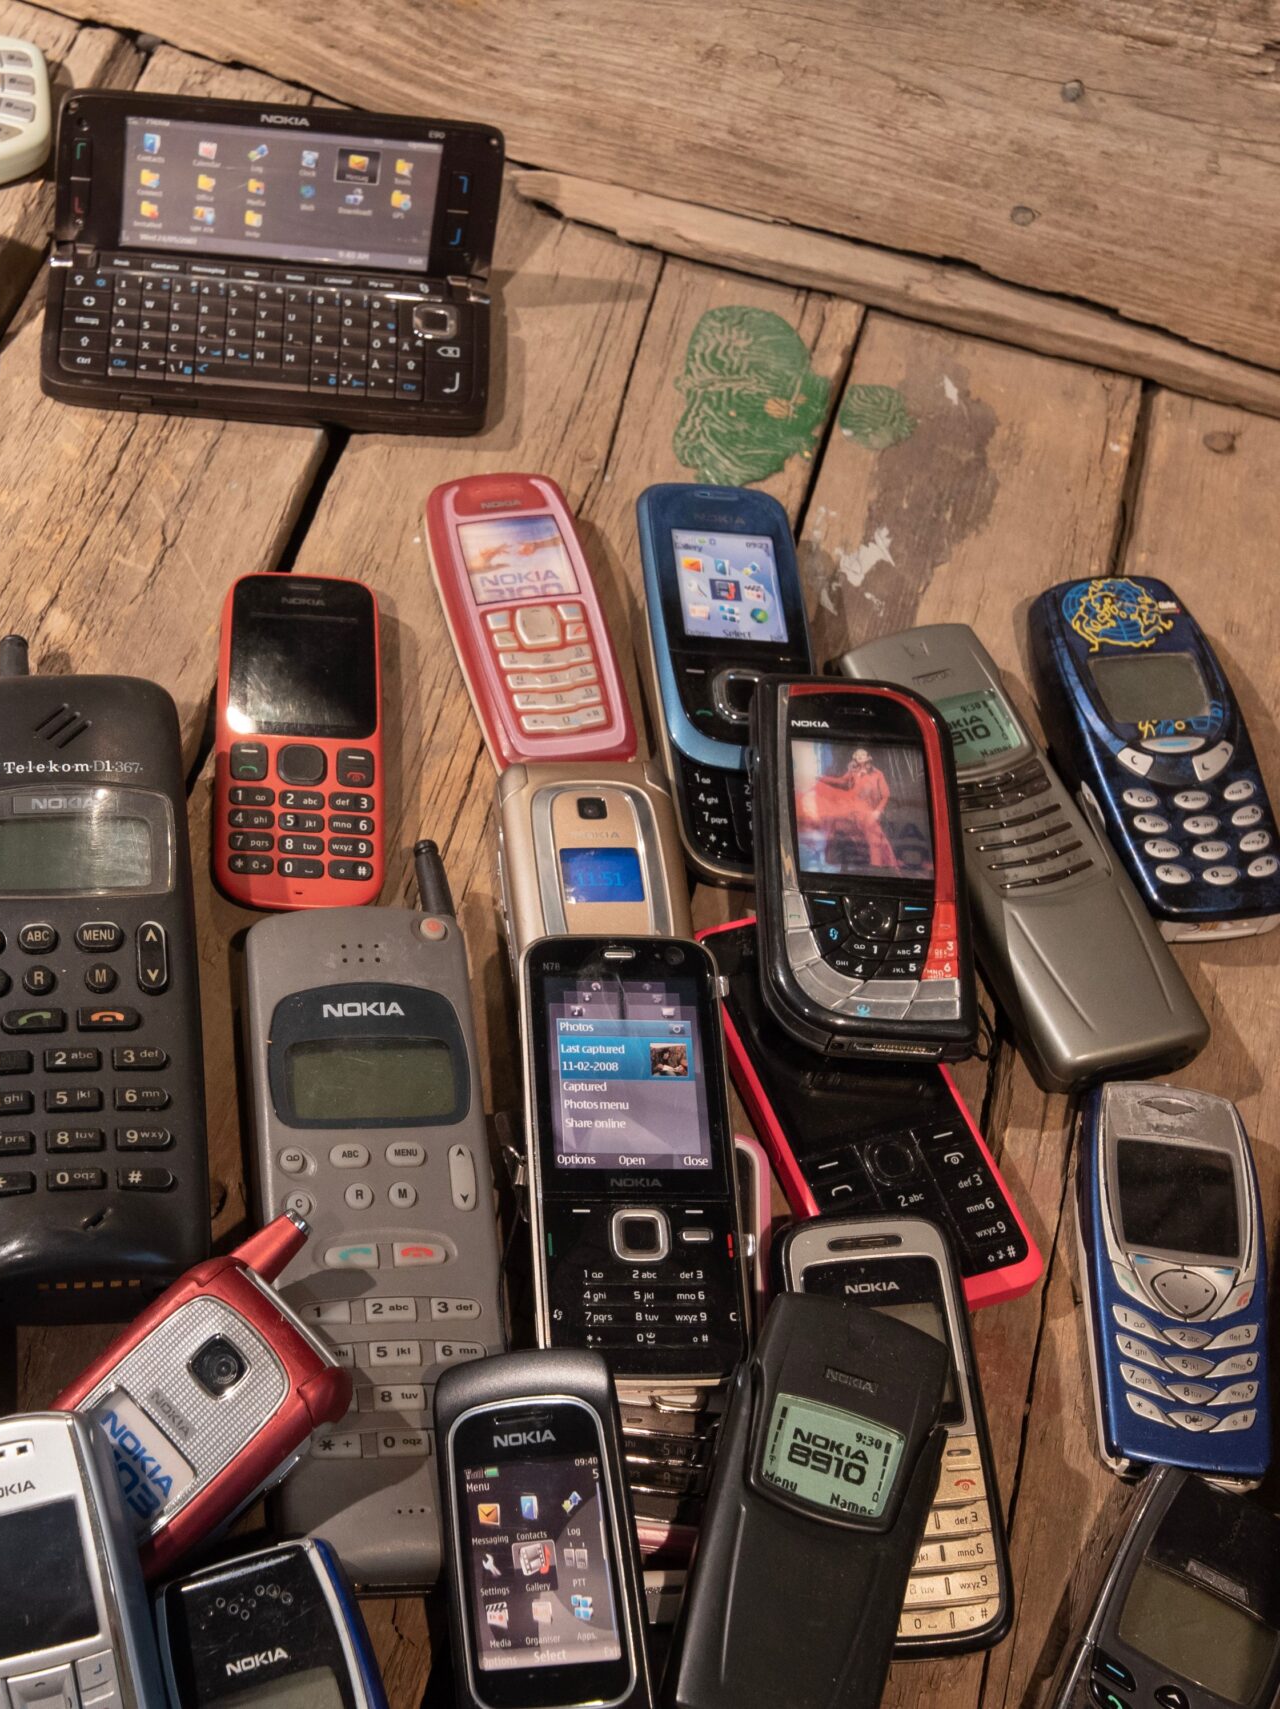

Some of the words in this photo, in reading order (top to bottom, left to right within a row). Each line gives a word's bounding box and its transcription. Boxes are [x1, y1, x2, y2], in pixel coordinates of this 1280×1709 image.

[260, 114, 310, 128] NOKIA
[428, 130, 445, 139] E90
[76, 356, 91, 365] Ctrl
[479, 569, 561, 588] NOKIA
[791, 719, 830, 729] NOKIA
[31, 797, 99, 811] NOKIA
[26, 929, 51, 942] ABC
[82, 928, 116, 942] MENU
[542, 962, 561, 971] N78
[322, 1001, 406, 1019] NOKIA
[559, 1022, 595, 1033] Photos
[561, 1043, 581, 1054] Last
[582, 1043, 626, 1056] captured
[54, 1052, 67, 1066] 2
[70, 1050, 94, 1060] abc
[561, 1061, 620, 1072] 11-02-2008
[563, 1081, 608, 1094] Captured
[564, 1099, 599, 1111] Photos
[600, 1101, 630, 1111] menu
[565, 1117, 593, 1129] Share
[594, 1118, 627, 1129] online
[56, 1131, 70, 1146] 8
[341, 1149, 360, 1160] ABC
[393, 1148, 419, 1158] MENU
[557, 1154, 597, 1166] Options
[618, 1155, 646, 1167] Open
[683, 1156, 709, 1167] Close
[609, 1177, 663, 1189] NOKIA
[845, 1281, 900, 1295] NOKIA
[389, 1303, 410, 1312] abc
[456, 1302, 473, 1312] def
[675, 1313, 698, 1323] wxyz
[825, 1369, 878, 1394] NOKIA
[150, 1391, 191, 1439] NOKIA
[493, 1429, 557, 1449] NOKIA
[792, 1426, 869, 1465] NOKIA
[855, 1431, 883, 1450] 9:30
[101, 1410, 174, 1498] NOKIA
[574, 1456, 598, 1467] 09:40
[787, 1442, 867, 1487] 8910
[466, 1481, 490, 1493] Menu
[516, 1529, 548, 1542] Contacts
[567, 1527, 581, 1537] Log
[471, 1533, 510, 1547] Messaging
[525, 1581, 551, 1594] Gallery
[572, 1578, 587, 1588] PTT
[480, 1585, 510, 1599] Settings
[489, 1637, 512, 1649] Media
[525, 1633, 561, 1646] Organiser
[225, 1646, 290, 1677] NOKIA
[533, 1649, 567, 1664] Select
